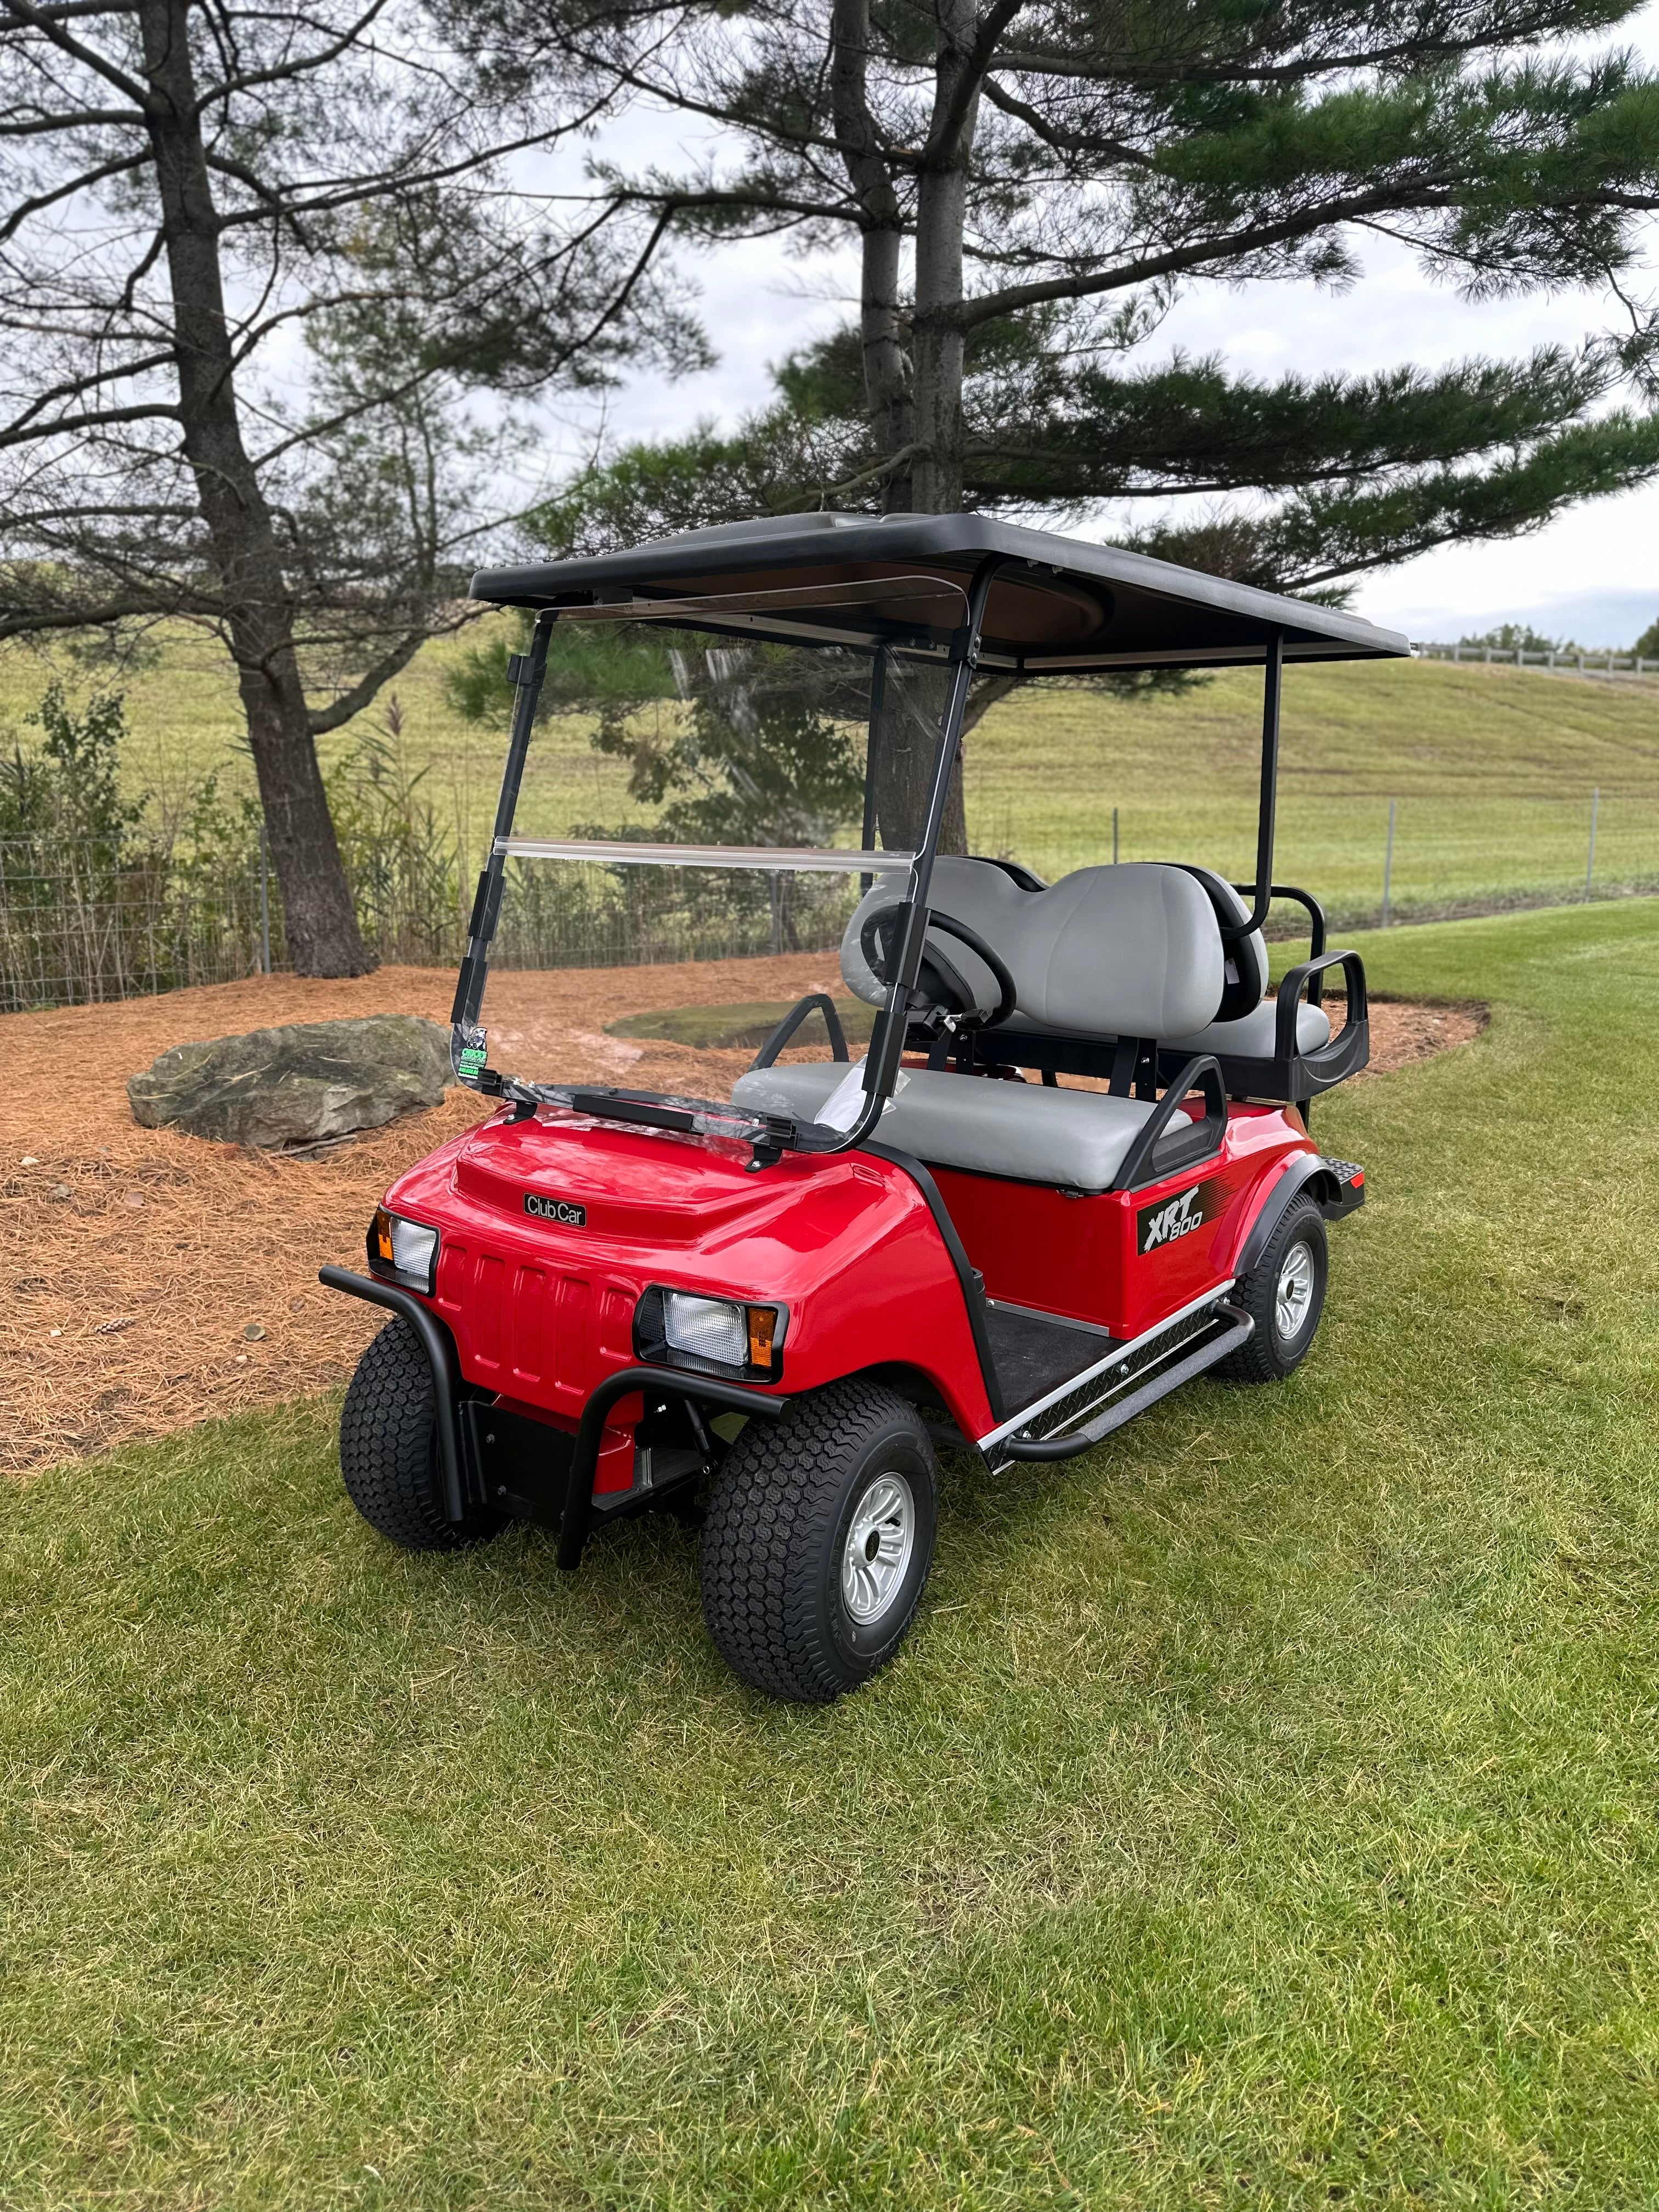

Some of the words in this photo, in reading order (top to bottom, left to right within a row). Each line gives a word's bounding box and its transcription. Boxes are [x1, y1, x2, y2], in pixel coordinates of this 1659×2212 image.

[527, 1196, 556, 1218] Club
[557, 1203, 582, 1224] Car
[1143, 1183, 1199, 1253] XRT
[1169, 1211, 1203, 1242] 800
